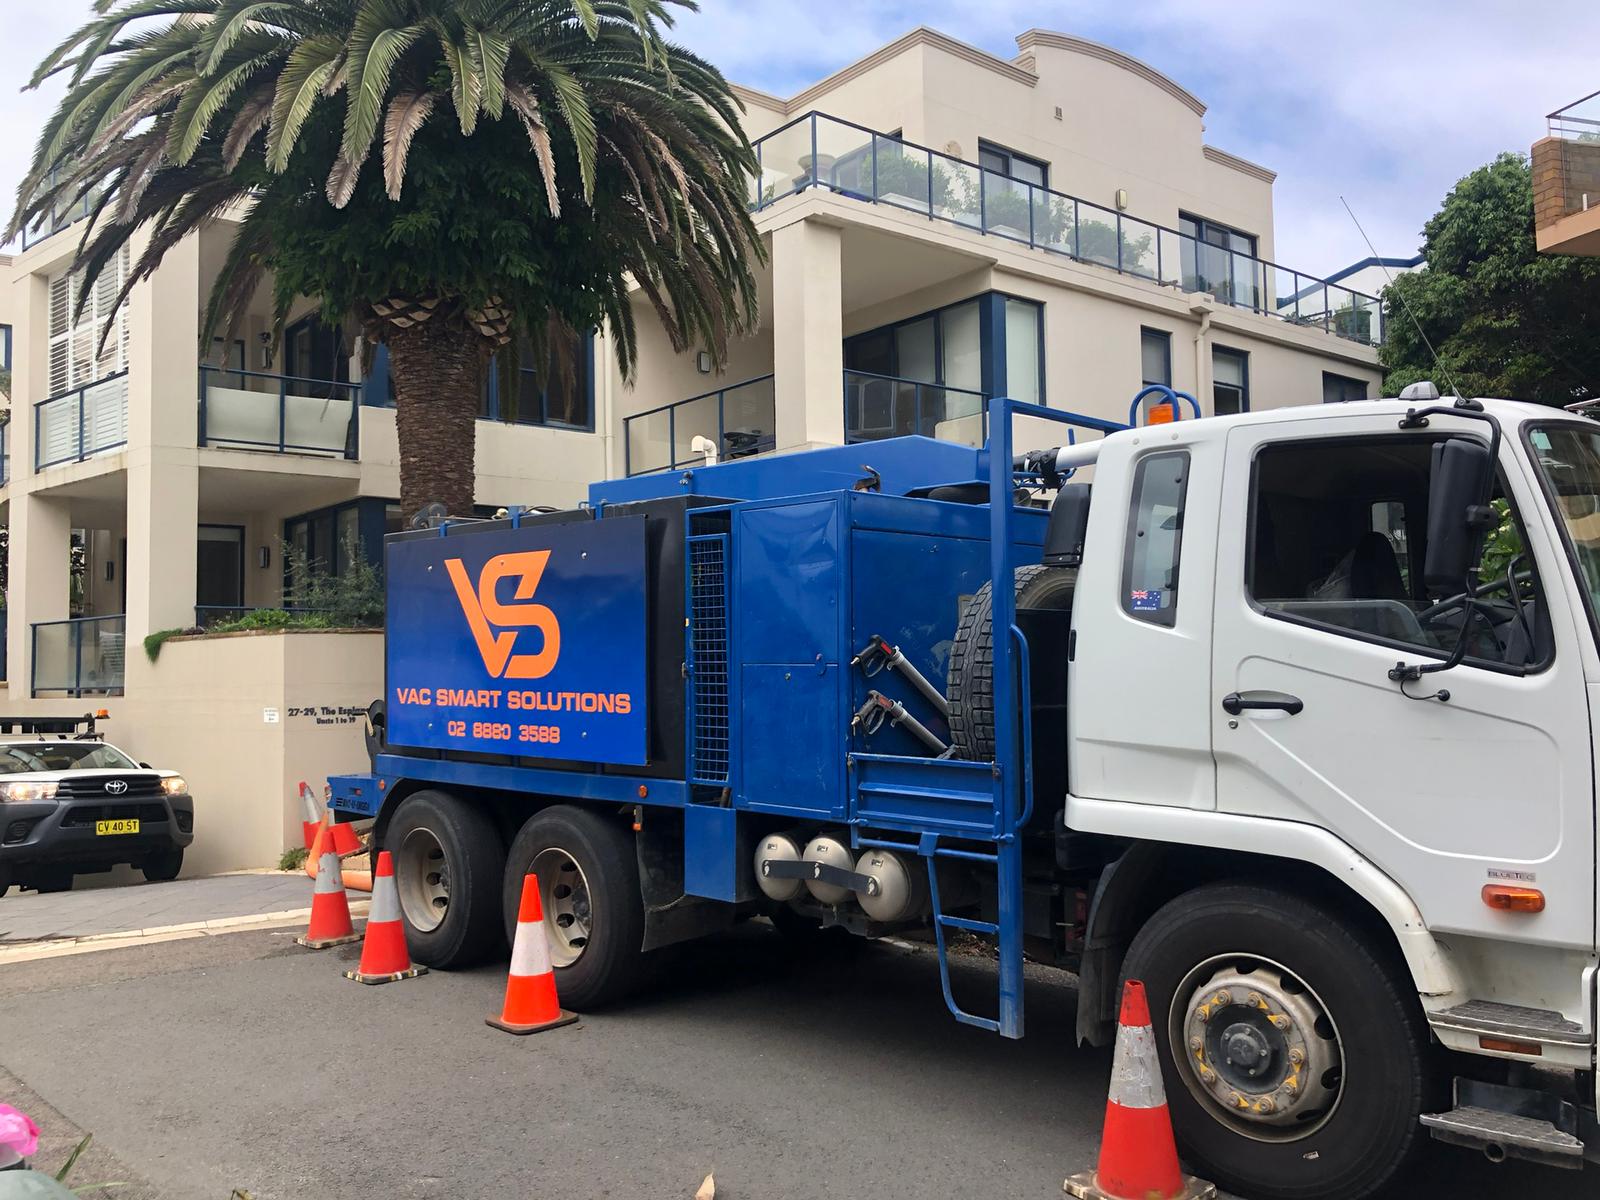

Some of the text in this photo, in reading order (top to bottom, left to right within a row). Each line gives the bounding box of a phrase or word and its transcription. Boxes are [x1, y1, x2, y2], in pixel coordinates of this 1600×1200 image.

[443, 549, 561, 679] VS
[287, 708, 317, 717] 27-29,
[321, 706, 336, 715] The
[396, 687, 631, 714] VAC SMART SOLUTIONS
[447, 721, 560, 744] 02 8880 3588
[98, 820, 138, 832] CV 40 ST
